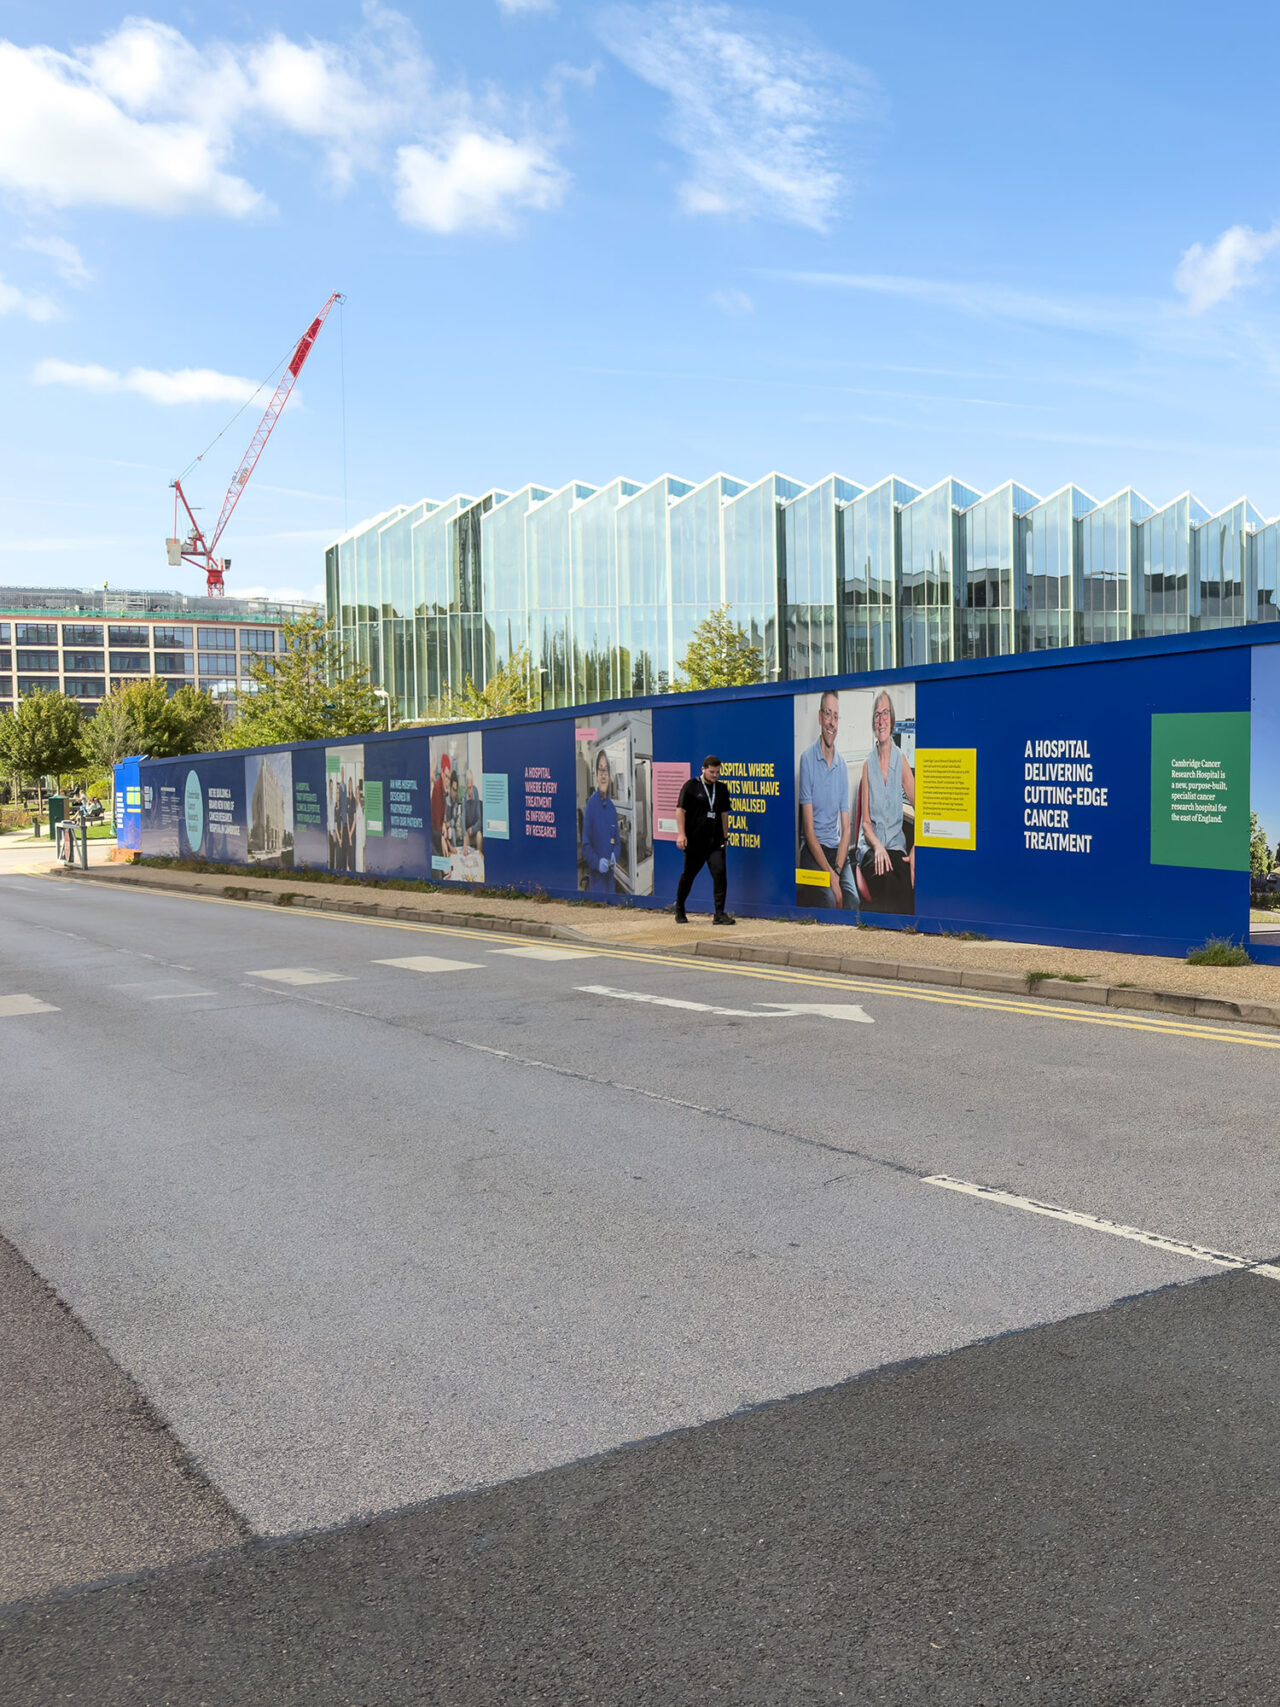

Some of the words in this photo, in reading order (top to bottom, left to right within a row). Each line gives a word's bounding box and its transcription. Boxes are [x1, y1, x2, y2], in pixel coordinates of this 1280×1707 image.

[1024, 740, 1033, 758] A
[1035, 740, 1091, 758] HOSPITAL
[719, 762, 748, 777] OSPITAL
[748, 763, 775, 777] WHERE
[1171, 759, 1200, 769] Cambridge
[1201, 759, 1221, 768] Cancer
[529, 767, 552, 779] HOSPITAL
[1024, 763, 1093, 782] DELIVERING
[1171, 769, 1195, 778] Research
[1196, 770, 1220, 780] Hospital
[1220, 770, 1225, 779] is
[525, 782, 541, 793] WHERE
[542, 782, 558, 794] EVERY
[741, 780, 759, 795] WILL
[760, 781, 780, 796] HAVE
[525, 796, 552, 808] TREATMENT
[1024, 786, 1108, 806] CUTTING-EDGE
[1171, 791, 1196, 801] specialist
[1171, 803, 1194, 811] research
[1195, 803, 1217, 813] hospital
[1218, 803, 1227, 812] for
[525, 810, 530, 822] IS
[531, 811, 556, 824] INFORMED
[727, 815, 749, 831] PLAN,
[1024, 808, 1069, 828] CANCER
[1171, 813, 1180, 821] the
[1192, 814, 1198, 822] of
[525, 824, 532, 836] BY
[532, 825, 557, 838] RESEARCH
[740, 833, 761, 848] THEM
[1024, 831, 1092, 853] TREATMENT
